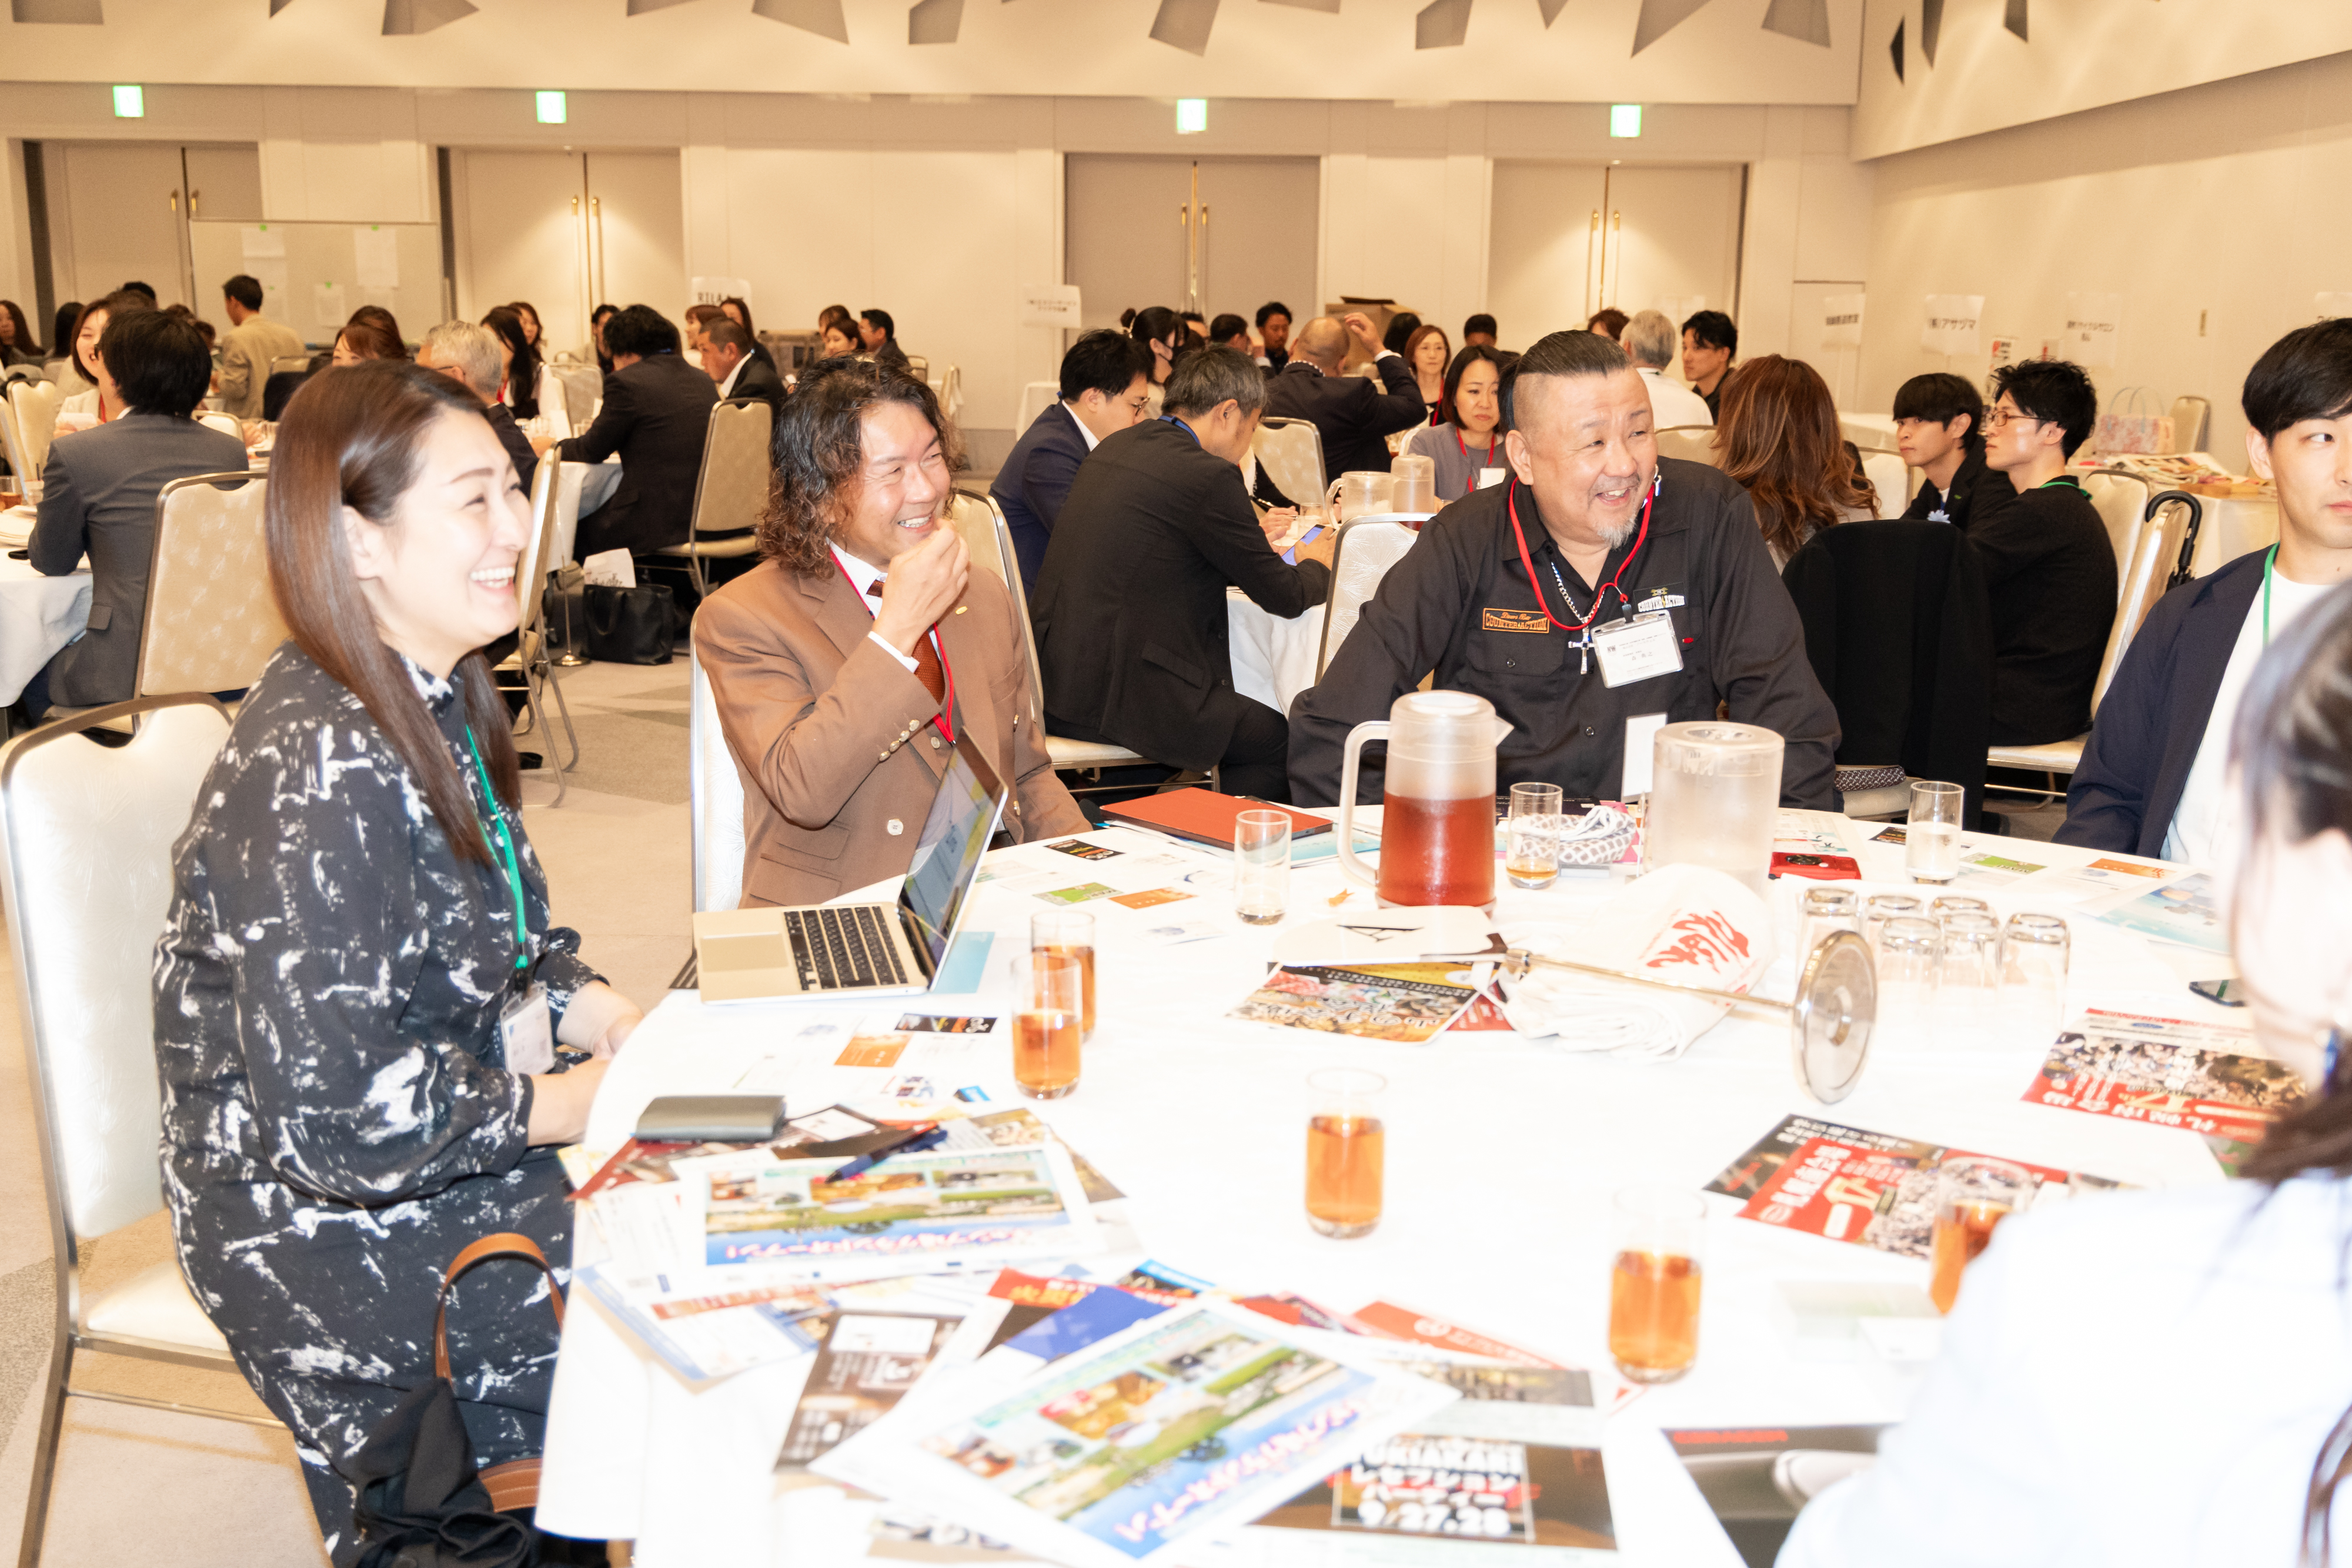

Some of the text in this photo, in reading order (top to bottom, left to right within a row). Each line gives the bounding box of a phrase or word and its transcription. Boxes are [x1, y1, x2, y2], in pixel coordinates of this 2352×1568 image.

[1638, 594, 1685, 612] COUNTER ACTION
[1485, 613, 1548, 631] COUNTER ACTION
